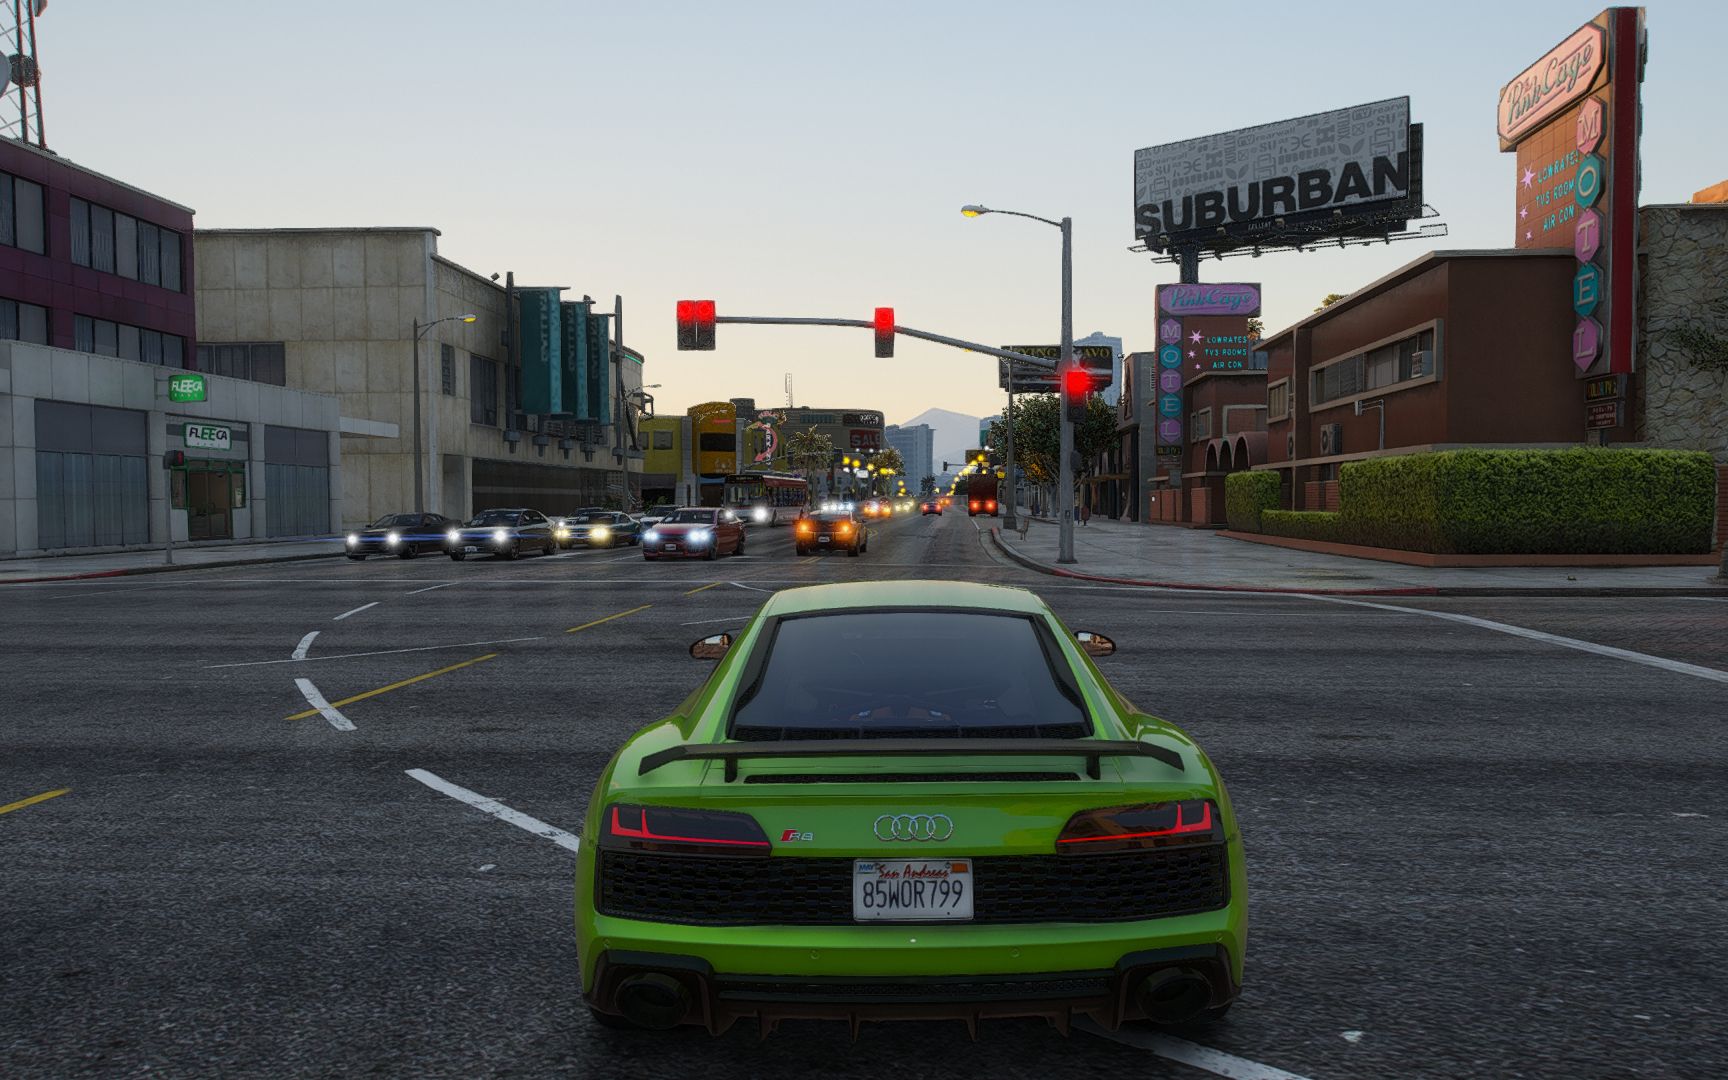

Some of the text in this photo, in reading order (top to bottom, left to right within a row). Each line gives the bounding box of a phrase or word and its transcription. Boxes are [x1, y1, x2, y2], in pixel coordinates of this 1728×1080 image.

[1507, 44, 1593, 126] Pink Cage
[1136, 151, 1409, 238] SUBURBAN
[1543, 204, 1575, 232] AIR CON
[1577, 106, 1599, 358] MOTEL
[1170, 288, 1251, 310] Pink Cage
[1222, 348, 1247, 356] ROOMS
[1212, 361, 1243, 369] AIR CON
[171, 379, 203, 393] FLEECA
[1161, 325, 1180, 436] MOTEL
[189, 426, 228, 441] FLEECA
[851, 432, 880, 448] SALE
[784, 830, 813, 841] R8
[878, 863, 900, 879] San
[902, 863, 950, 879] Andreas
[863, 880, 963, 909] 85WOR799
